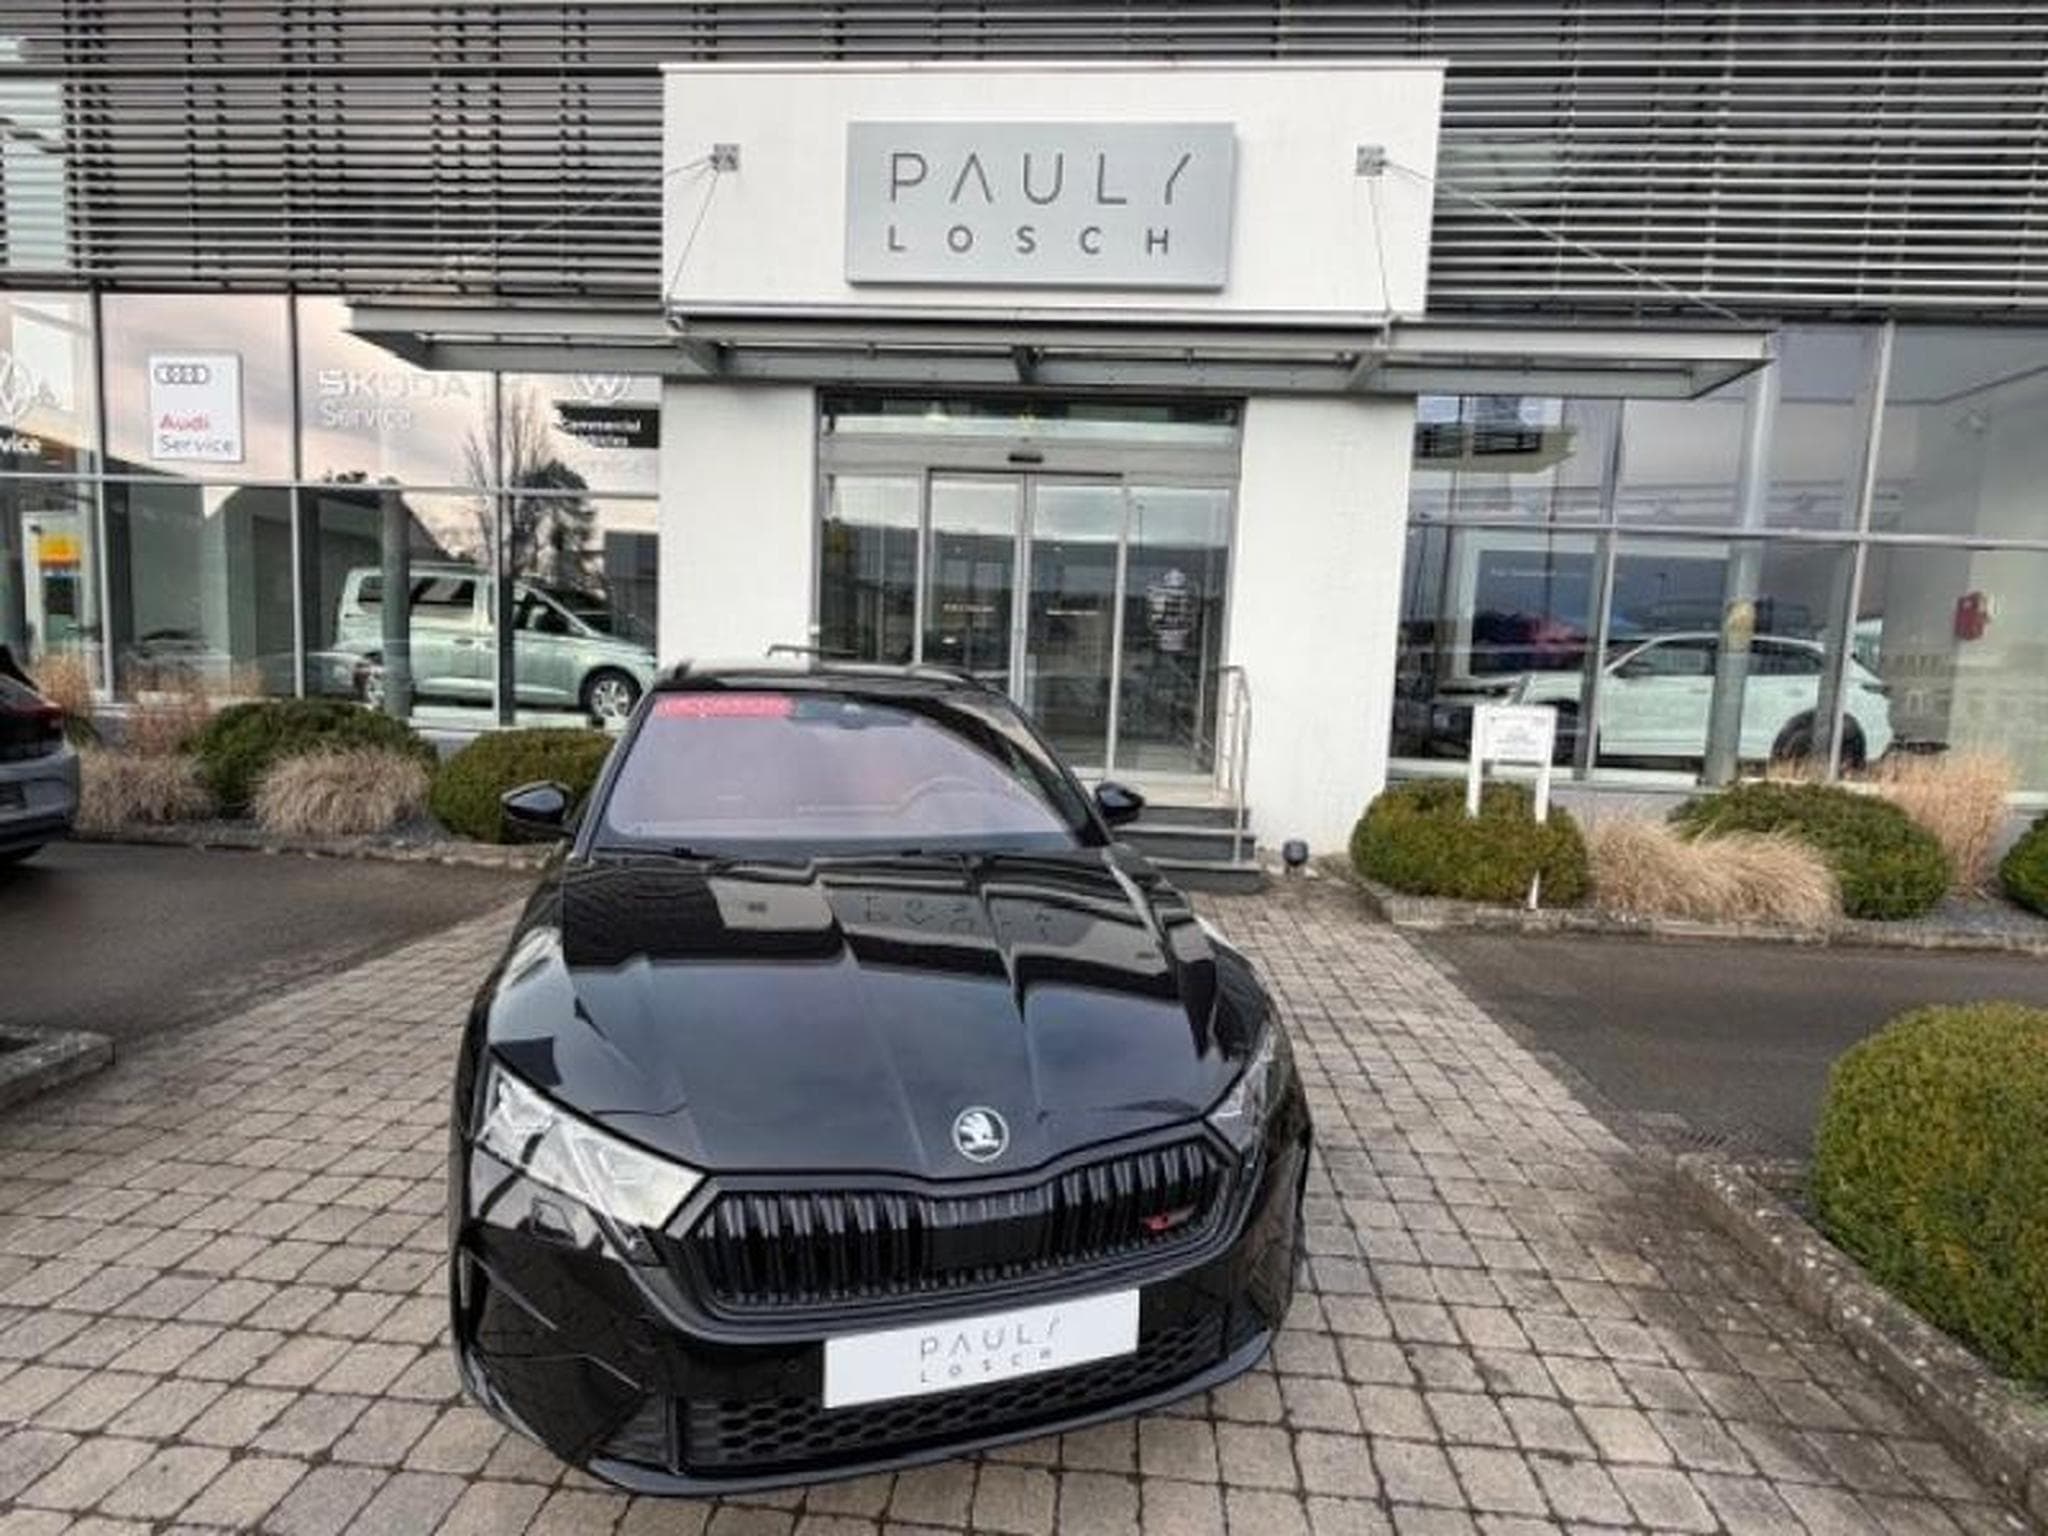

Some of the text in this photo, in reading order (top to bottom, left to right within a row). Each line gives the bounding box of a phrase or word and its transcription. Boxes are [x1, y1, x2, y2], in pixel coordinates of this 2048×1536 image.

[889, 152, 1192, 205] PAULY
[888, 224, 1170, 255] LOSCH
[160, 413, 209, 432] Audi
[160, 434, 236, 454] Service
[920, 1315, 1061, 1358] PAULY
[920, 1349, 1052, 1383] LOSCH
